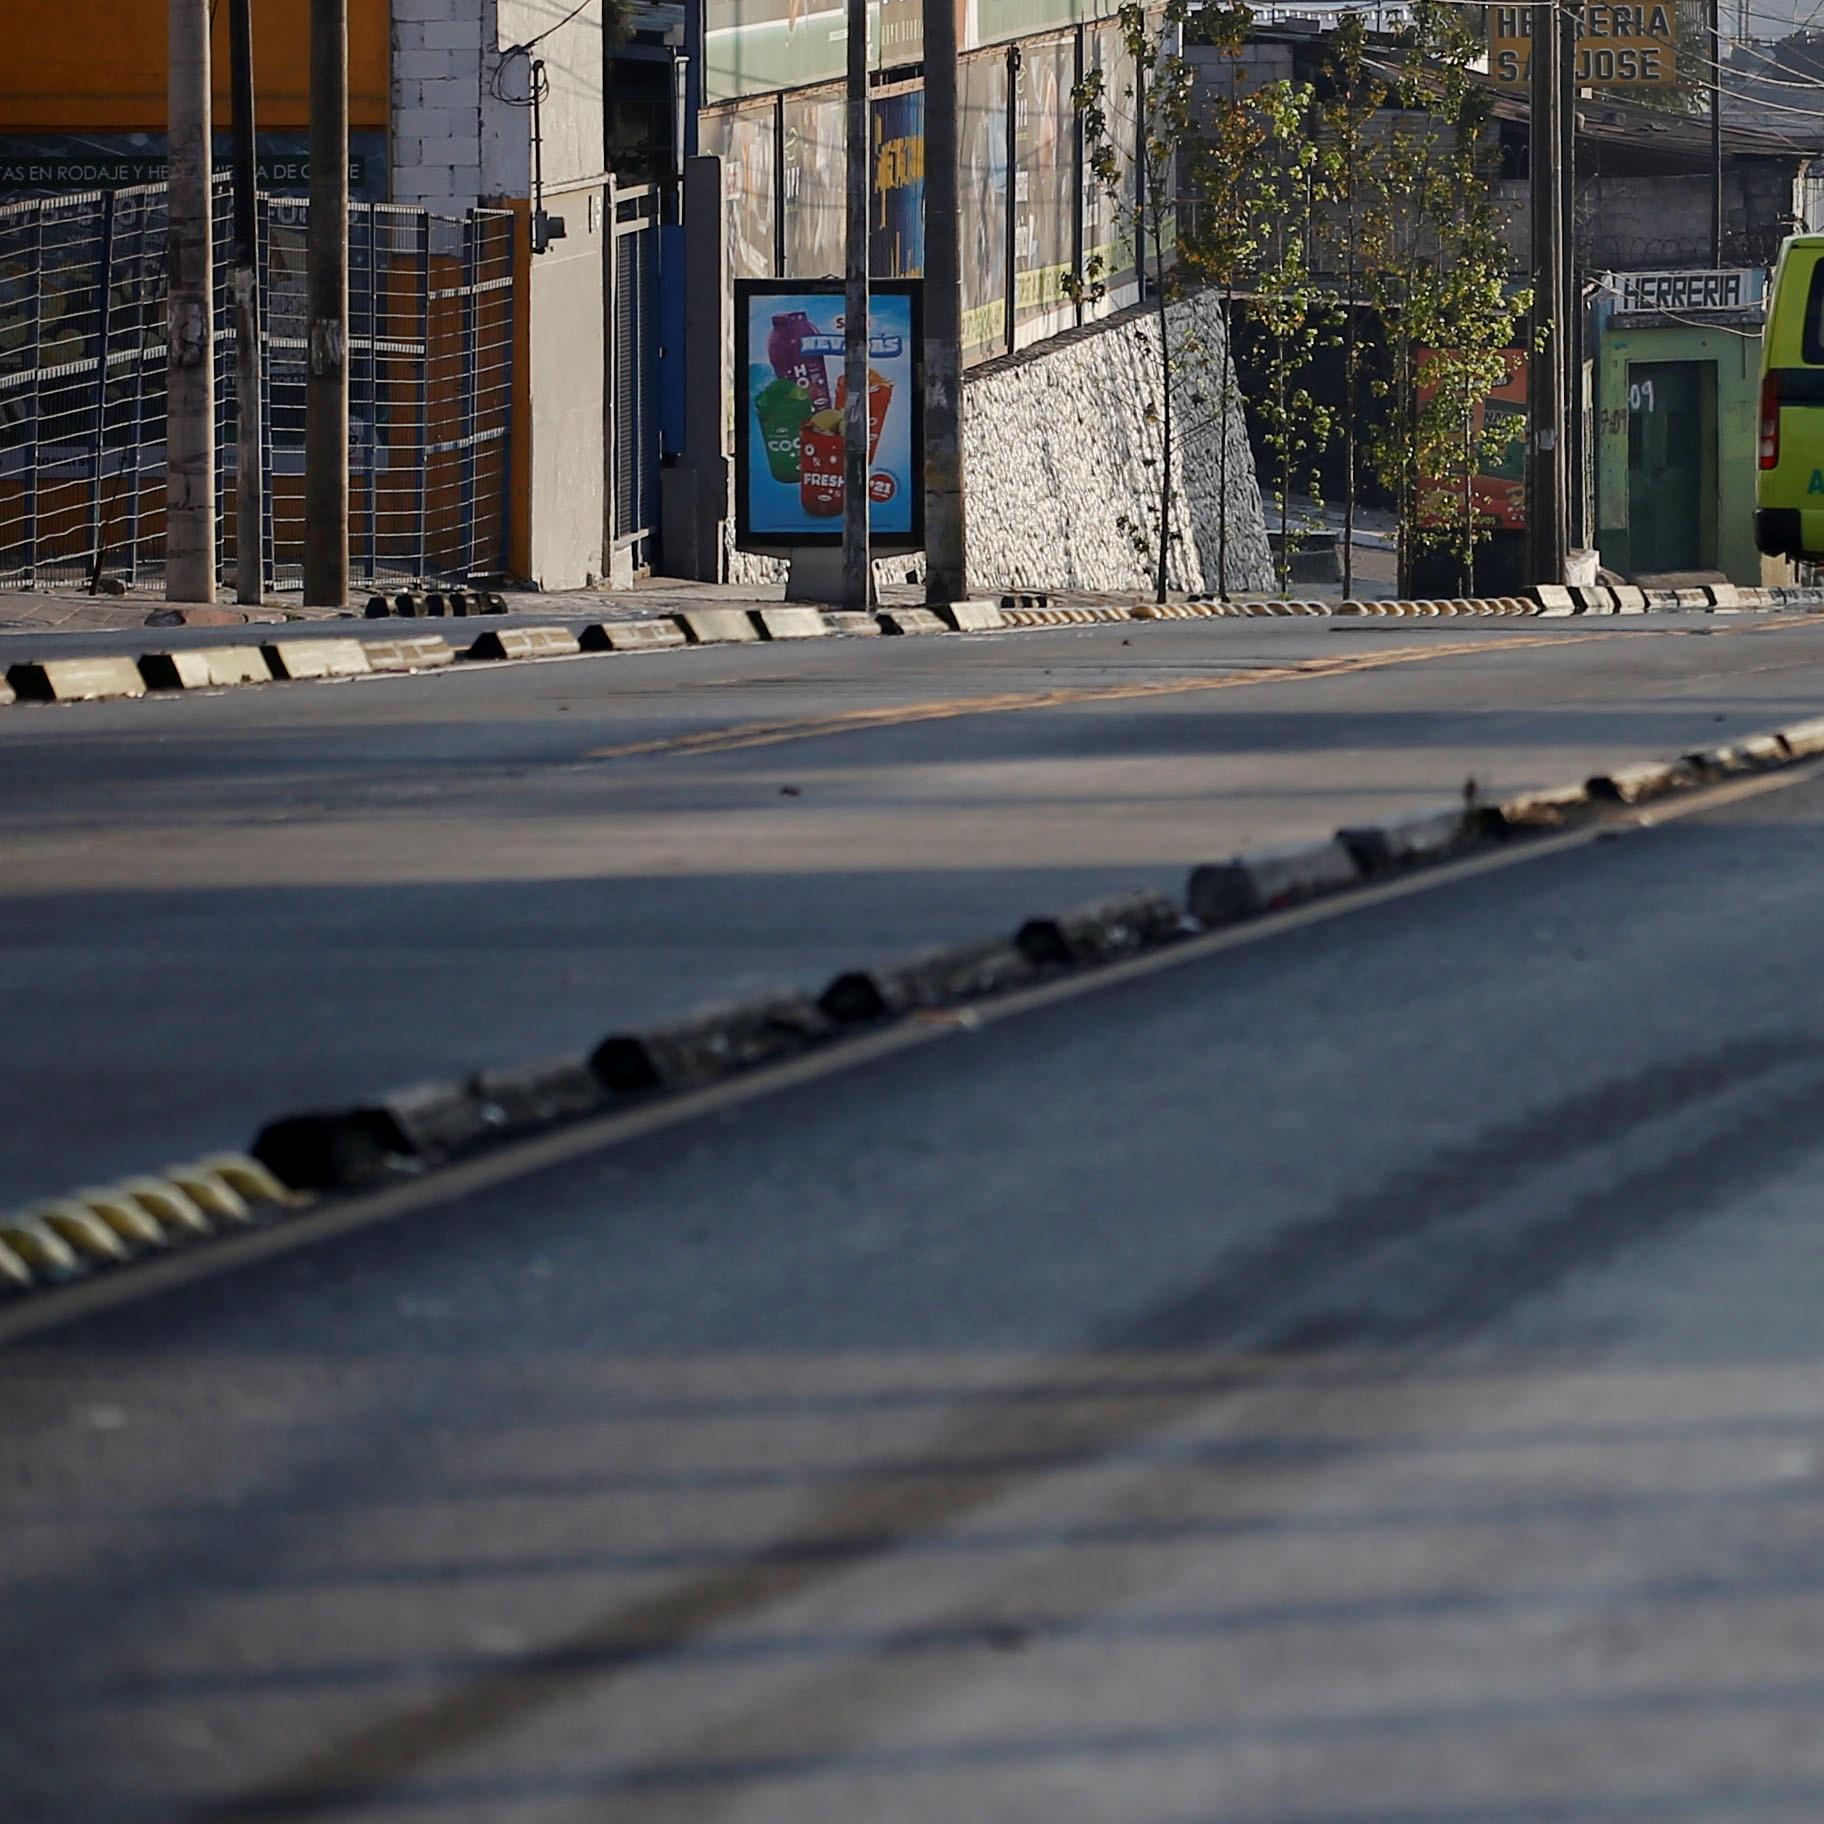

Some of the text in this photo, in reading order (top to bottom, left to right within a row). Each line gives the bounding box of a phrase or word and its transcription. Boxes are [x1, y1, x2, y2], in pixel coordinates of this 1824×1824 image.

[1575, 47, 1662, 81] JOSE
[31, 165, 53, 181] EN
[58, 165, 129, 181] RODAJE
[131, 165, 142, 180] Y
[273, 164, 298, 180] DE
[1623, 274, 1741, 310] HERRERIA
